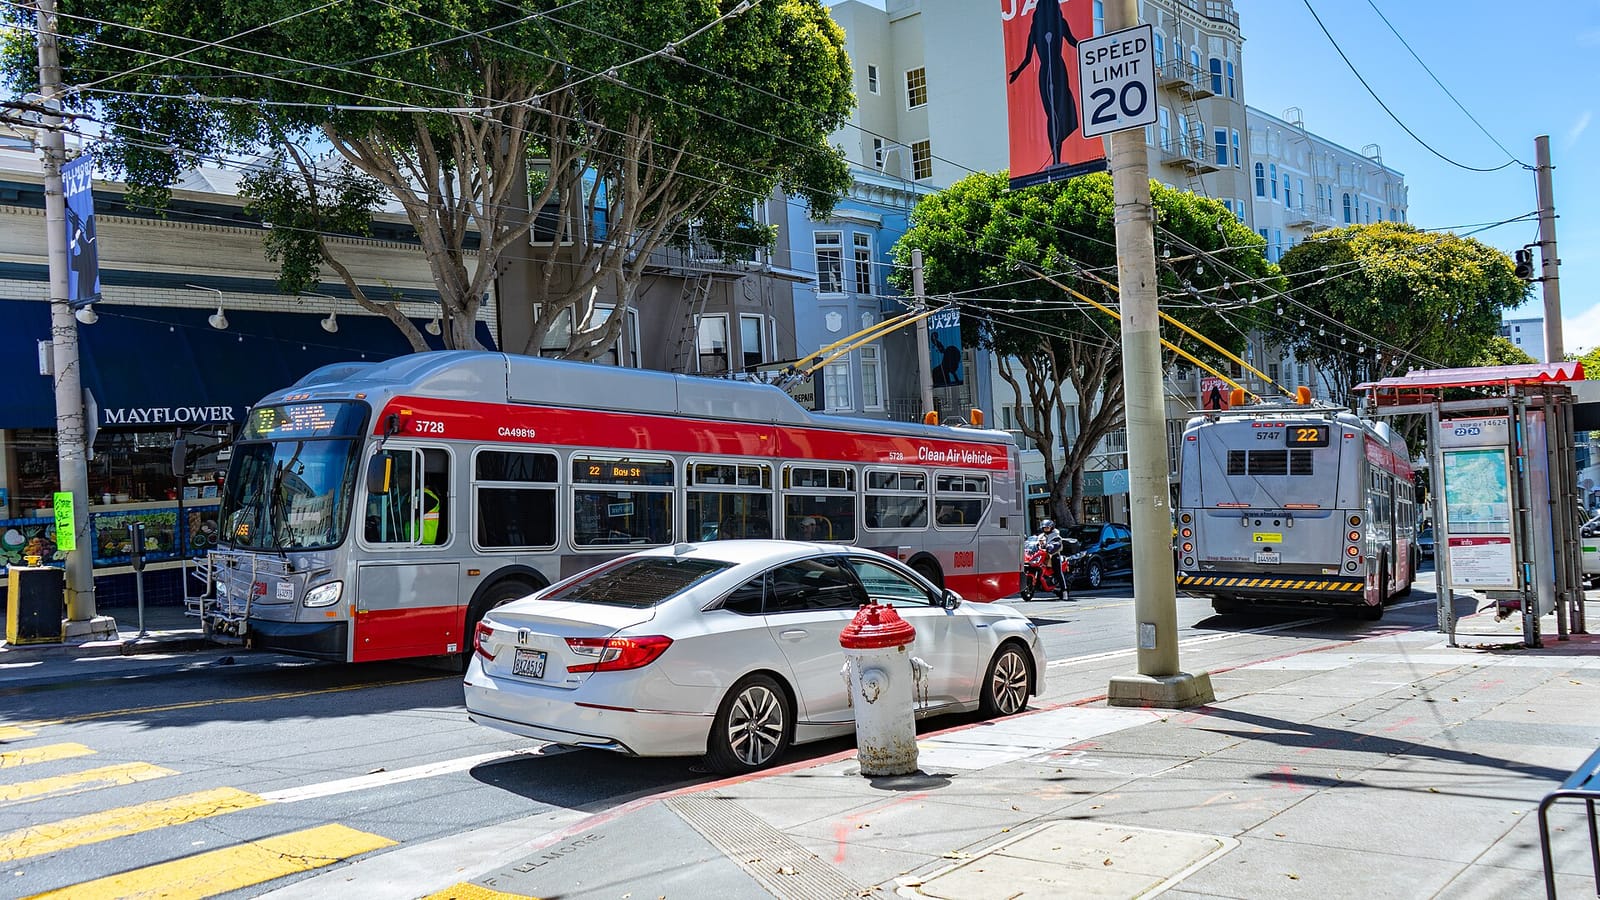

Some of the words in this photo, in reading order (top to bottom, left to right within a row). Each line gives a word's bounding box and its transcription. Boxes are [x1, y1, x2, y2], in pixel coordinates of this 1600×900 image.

[1085, 38, 1147, 66] SPEED
[1093, 59, 1141, 84] LIMIT
[1089, 80, 1148, 125] 20
[64, 173, 92, 198] JAZZ
[928, 316, 961, 330] JAZZ
[104, 406, 235, 424] MAYFLOWER
[1483, 419, 1507, 427] 14624
[497, 426, 536, 438] CA49819
[1256, 431, 1280, 440] 5747
[1296, 428, 1318, 442] 22
[1456, 428, 1465, 436] 22
[889, 452, 904, 461] 5728
[918, 446, 945, 462] Clean
[946, 448, 961, 463] Air
[961, 450, 993, 465] Vehicle
[589, 466, 600, 476] 22
[613, 467, 628, 477] Bay
[630, 467, 641, 477] St
